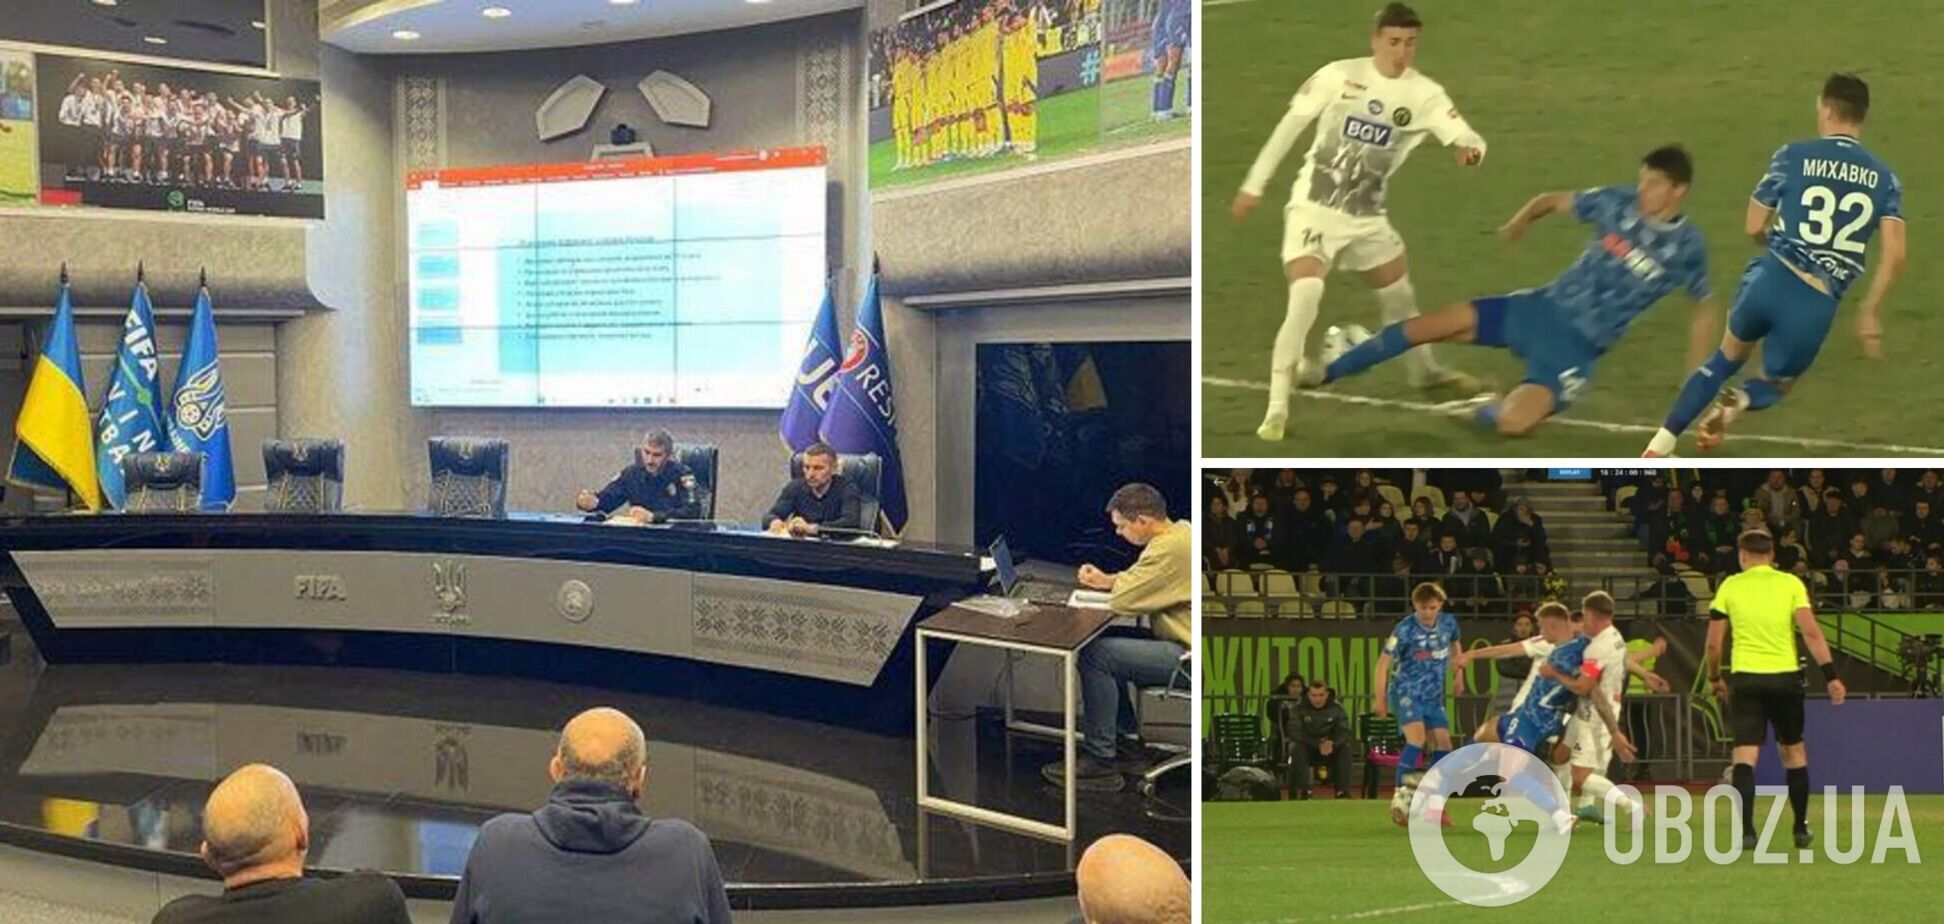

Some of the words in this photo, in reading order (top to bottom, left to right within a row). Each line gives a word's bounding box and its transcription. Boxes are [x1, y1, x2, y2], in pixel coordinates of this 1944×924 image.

[1347, 120, 1388, 143] BGV
[1803, 158, 1878, 189] МИХАВКО
[1799, 187, 1874, 254] 32
[124, 309, 158, 382] FIFA
[295, 575, 347, 601] FIFA
